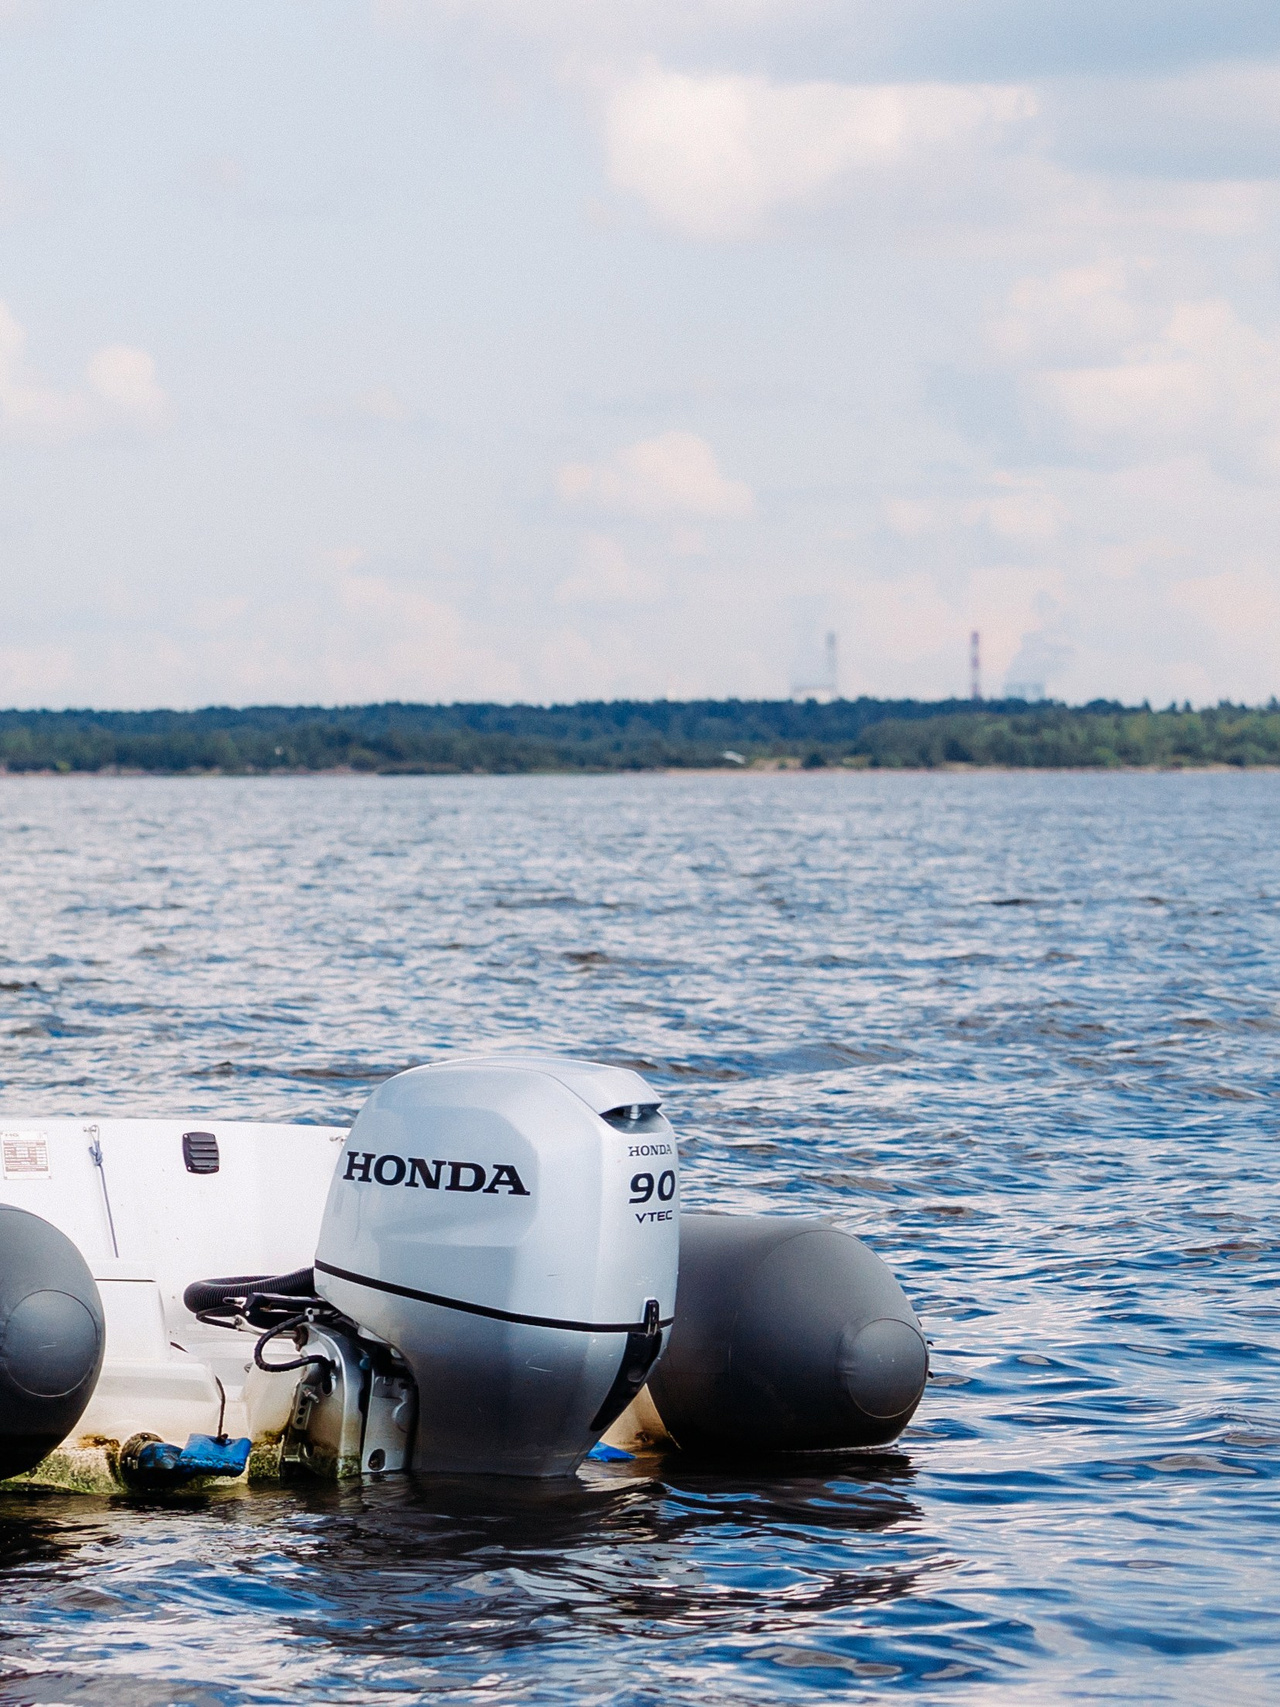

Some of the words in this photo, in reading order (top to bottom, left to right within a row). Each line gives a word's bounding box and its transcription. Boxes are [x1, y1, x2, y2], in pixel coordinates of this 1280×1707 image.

[628, 1144, 673, 1157] HONDA
[342, 1151, 531, 1196] HONDA
[628, 1170, 676, 1204] 90
[634, 1209, 674, 1224] VTEC
